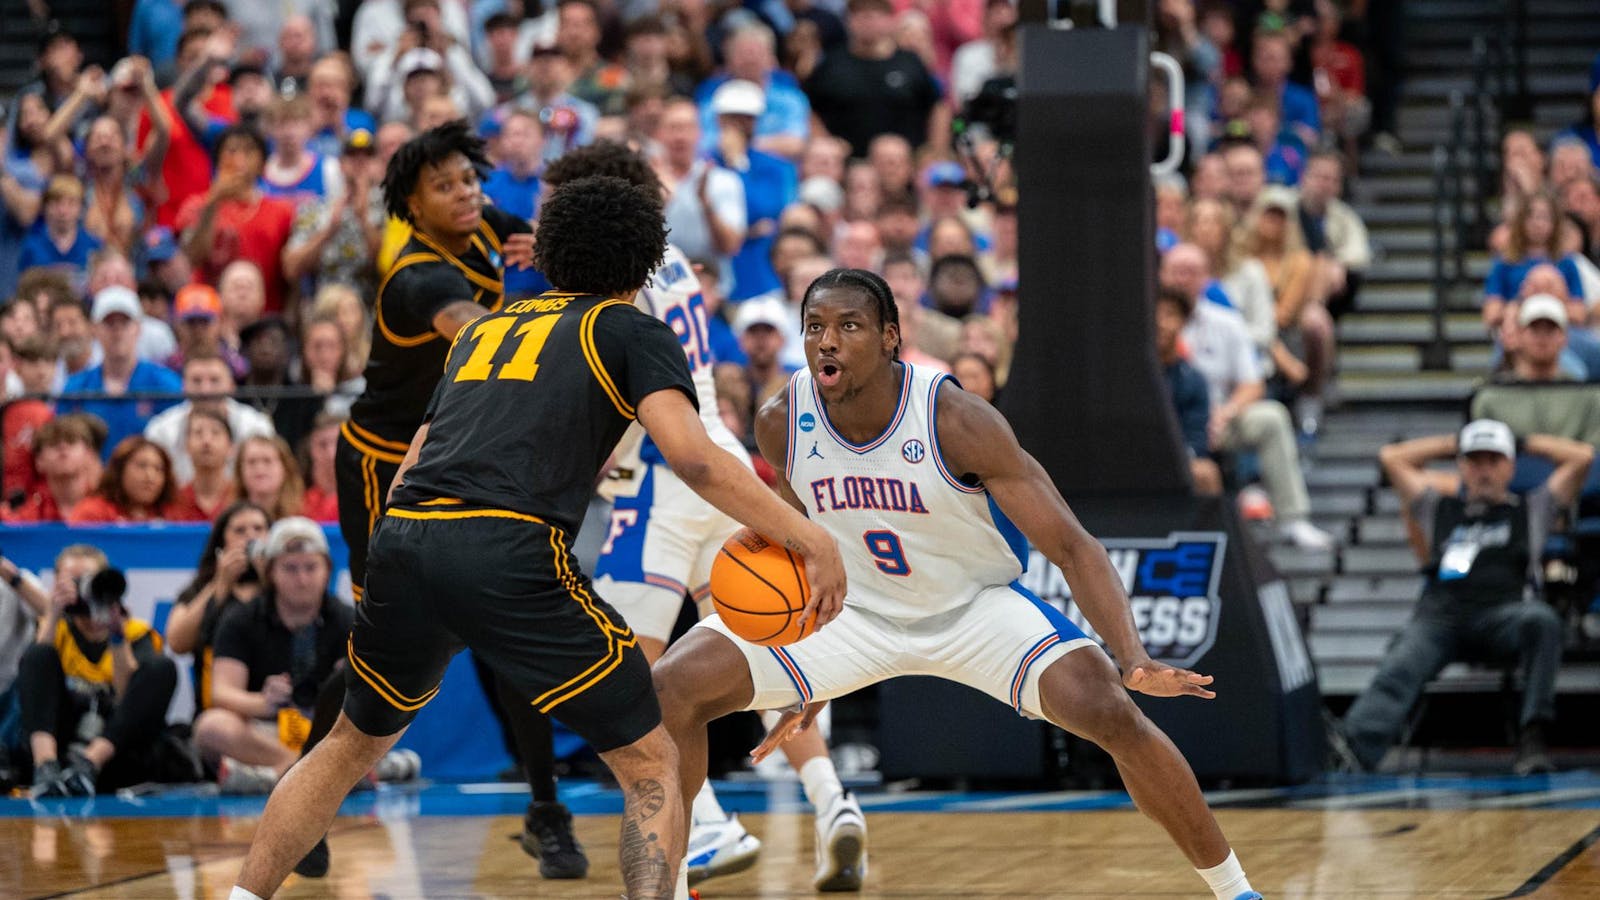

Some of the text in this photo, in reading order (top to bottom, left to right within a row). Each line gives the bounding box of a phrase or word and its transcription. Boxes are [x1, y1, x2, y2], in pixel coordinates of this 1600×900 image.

[504, 297, 575, 313] COMBS
[453, 313, 564, 383] 11
[810, 476, 930, 514] FLORIDA
[601, 509, 638, 554] F
[863, 530, 912, 577] 9
